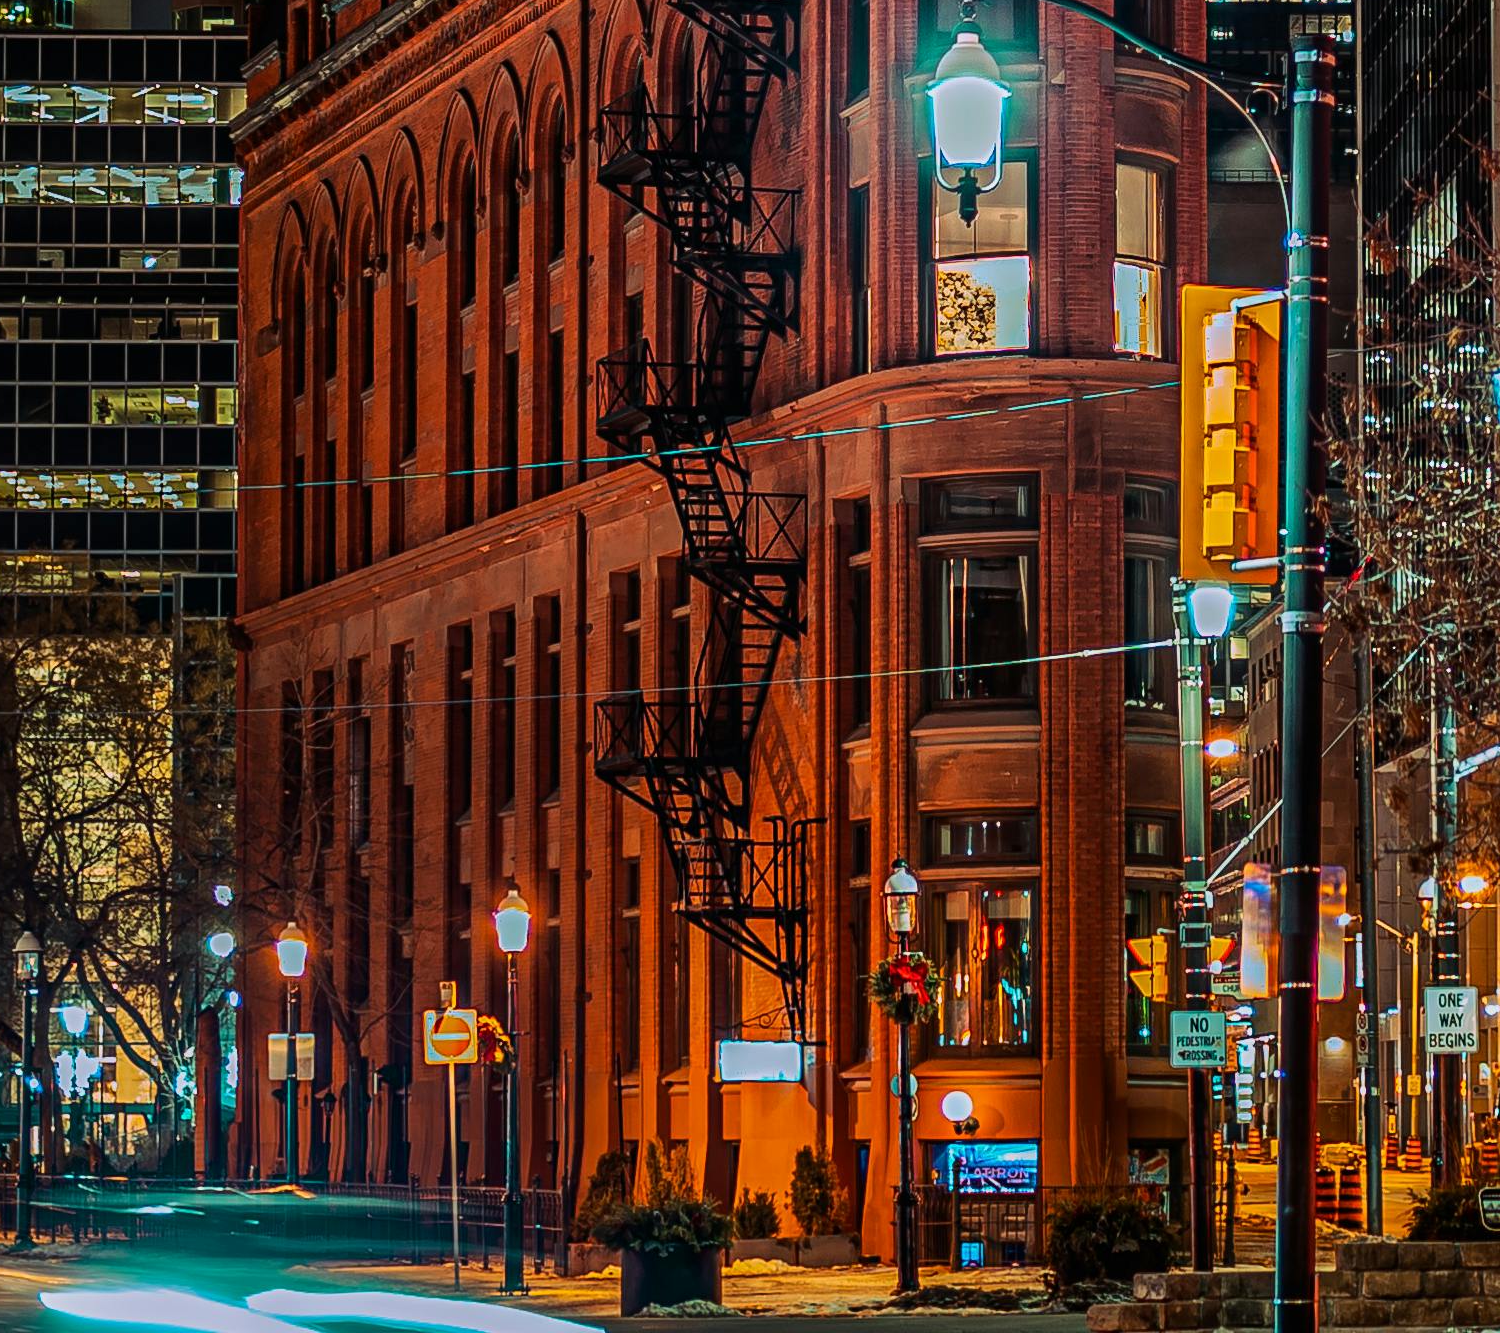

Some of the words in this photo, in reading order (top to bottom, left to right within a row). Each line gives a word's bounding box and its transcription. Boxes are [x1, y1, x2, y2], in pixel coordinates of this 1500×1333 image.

[1438, 992, 1465, 1008] ONE
[1189, 1017, 1209, 1033] NO
[1439, 1012, 1464, 1028] WAY
[1429, 1032, 1475, 1048] BEGINS
[959, 1166, 1029, 1179] LATIRON
